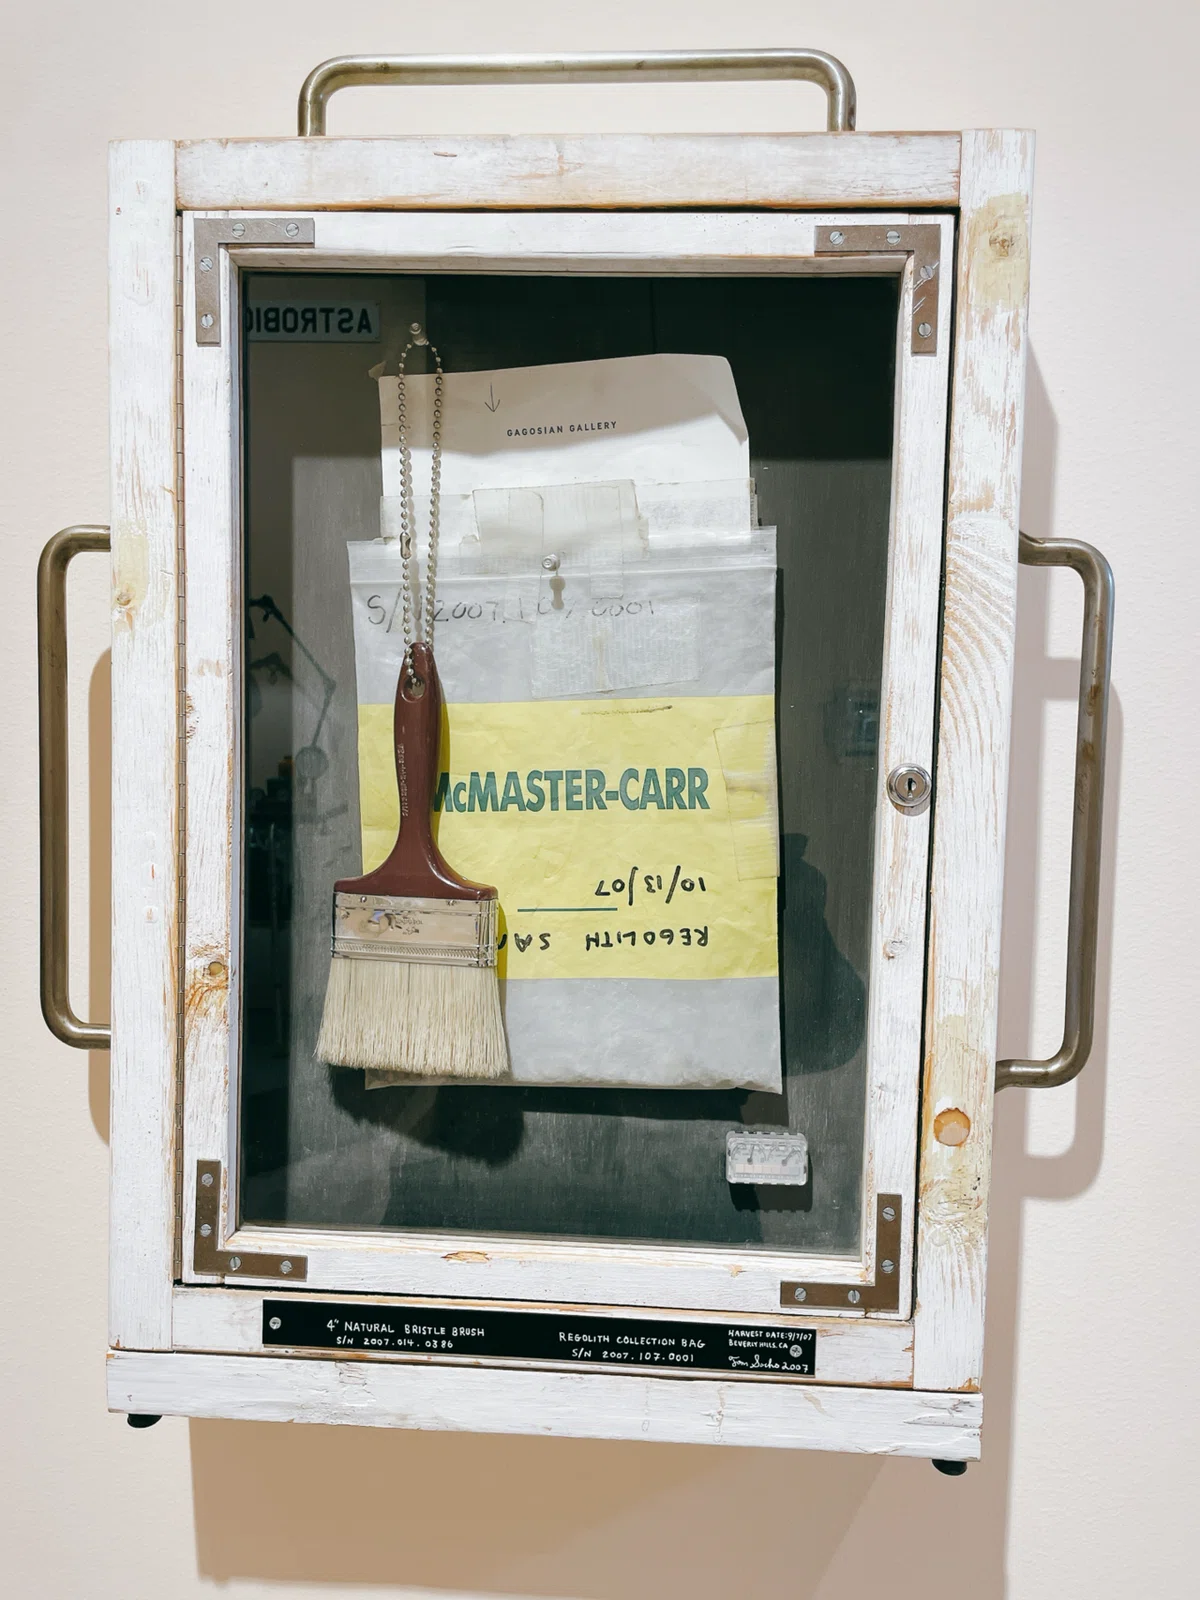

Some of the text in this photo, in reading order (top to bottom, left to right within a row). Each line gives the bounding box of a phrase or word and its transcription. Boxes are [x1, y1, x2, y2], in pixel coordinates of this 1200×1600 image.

[506, 420, 617, 437] GAGOSIAN GALLERY
[594, 865, 706, 906] 10/13/07
[497, 925, 708, 953] REGOLITH SA
[344, 1321, 395, 1334] NATURAL
[404, 1323, 446, 1336] BRISTLE
[451, 1326, 485, 1337] BRUSH
[727, 1329, 764, 1338] HARVEST
[336, 1334, 354, 1345] S/N
[558, 1331, 706, 1349] REGOLITH COLLECTION BAG
[728, 1338, 758, 1348] BEVERLY
[779, 1341, 789, 1349] CA
[571, 1347, 592, 1359] S/N
[781, 1361, 809, 1374] 2007
